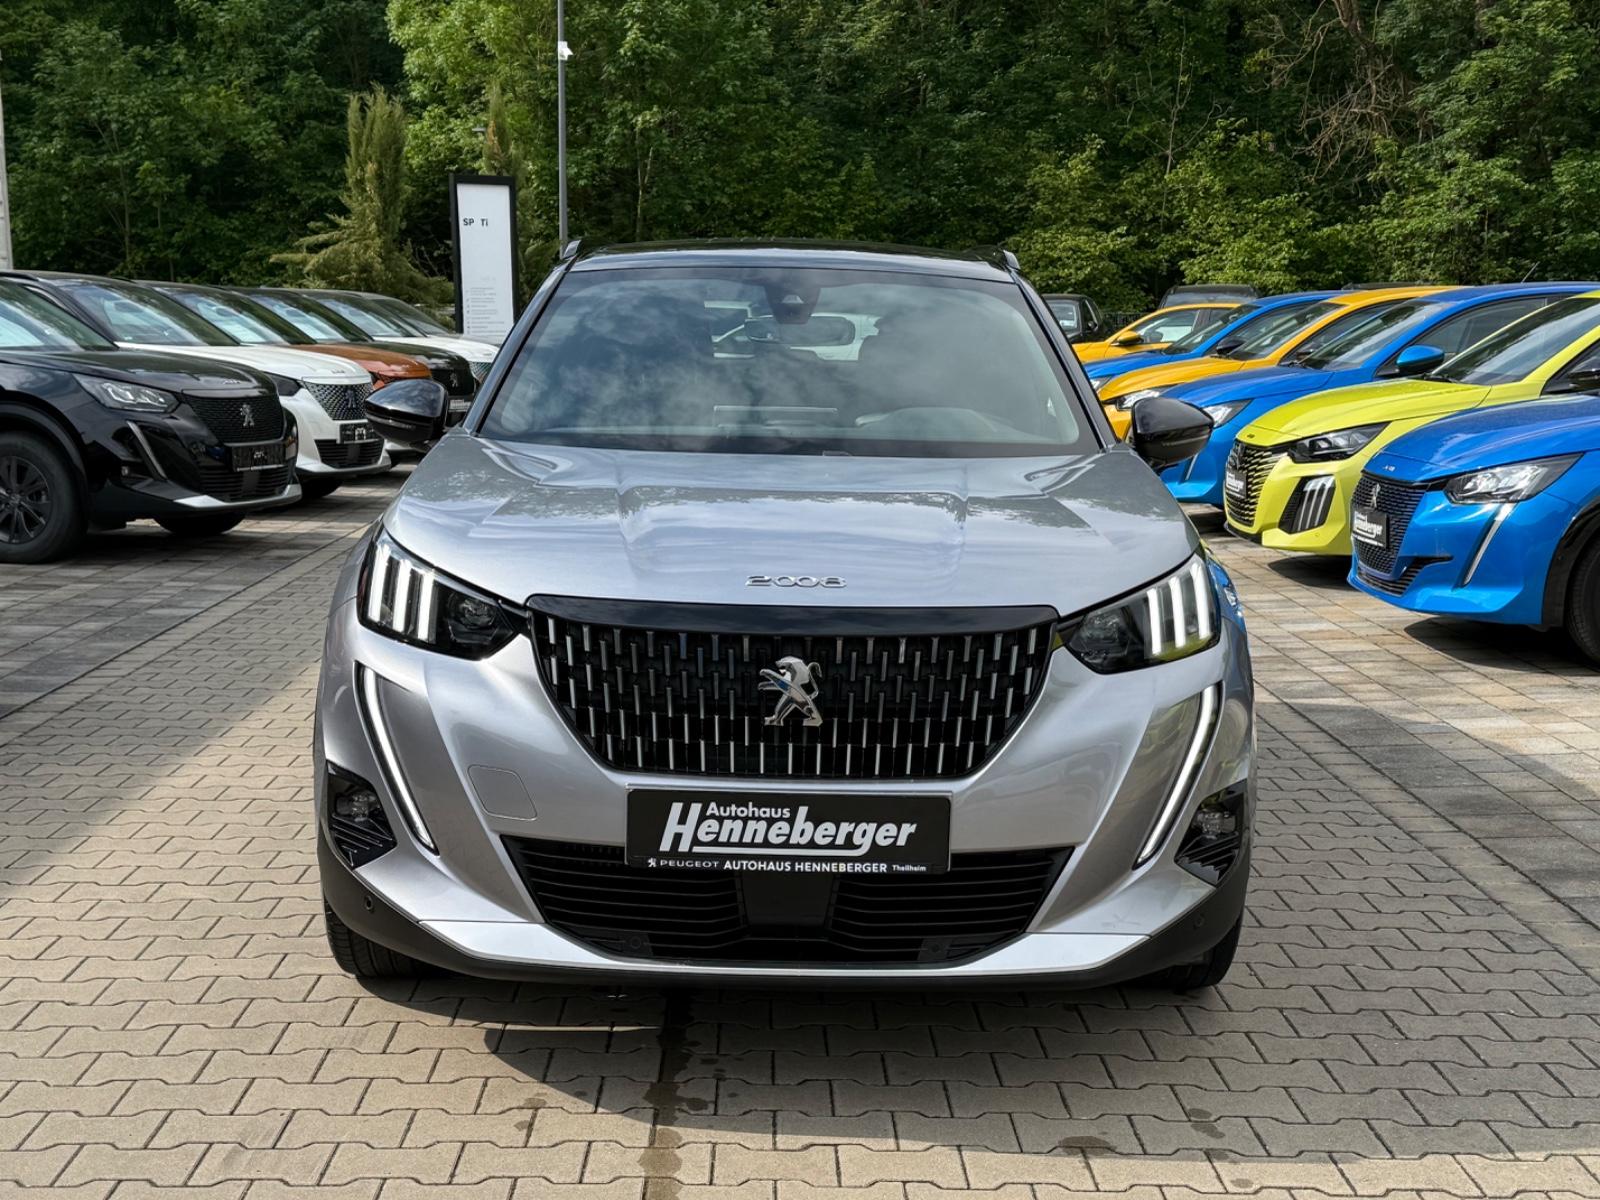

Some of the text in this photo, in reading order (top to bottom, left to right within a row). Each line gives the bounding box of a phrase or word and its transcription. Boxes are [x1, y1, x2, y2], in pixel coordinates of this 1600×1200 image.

[745, 575, 847, 589] 2008
[706, 801, 791, 819] Autohaus
[659, 802, 917, 857] Henneberger
[660, 859, 719, 868] PEUGEOT
[723, 860, 791, 872] AUTOHAUS
[794, 862, 888, 873] HENNEBERGER
